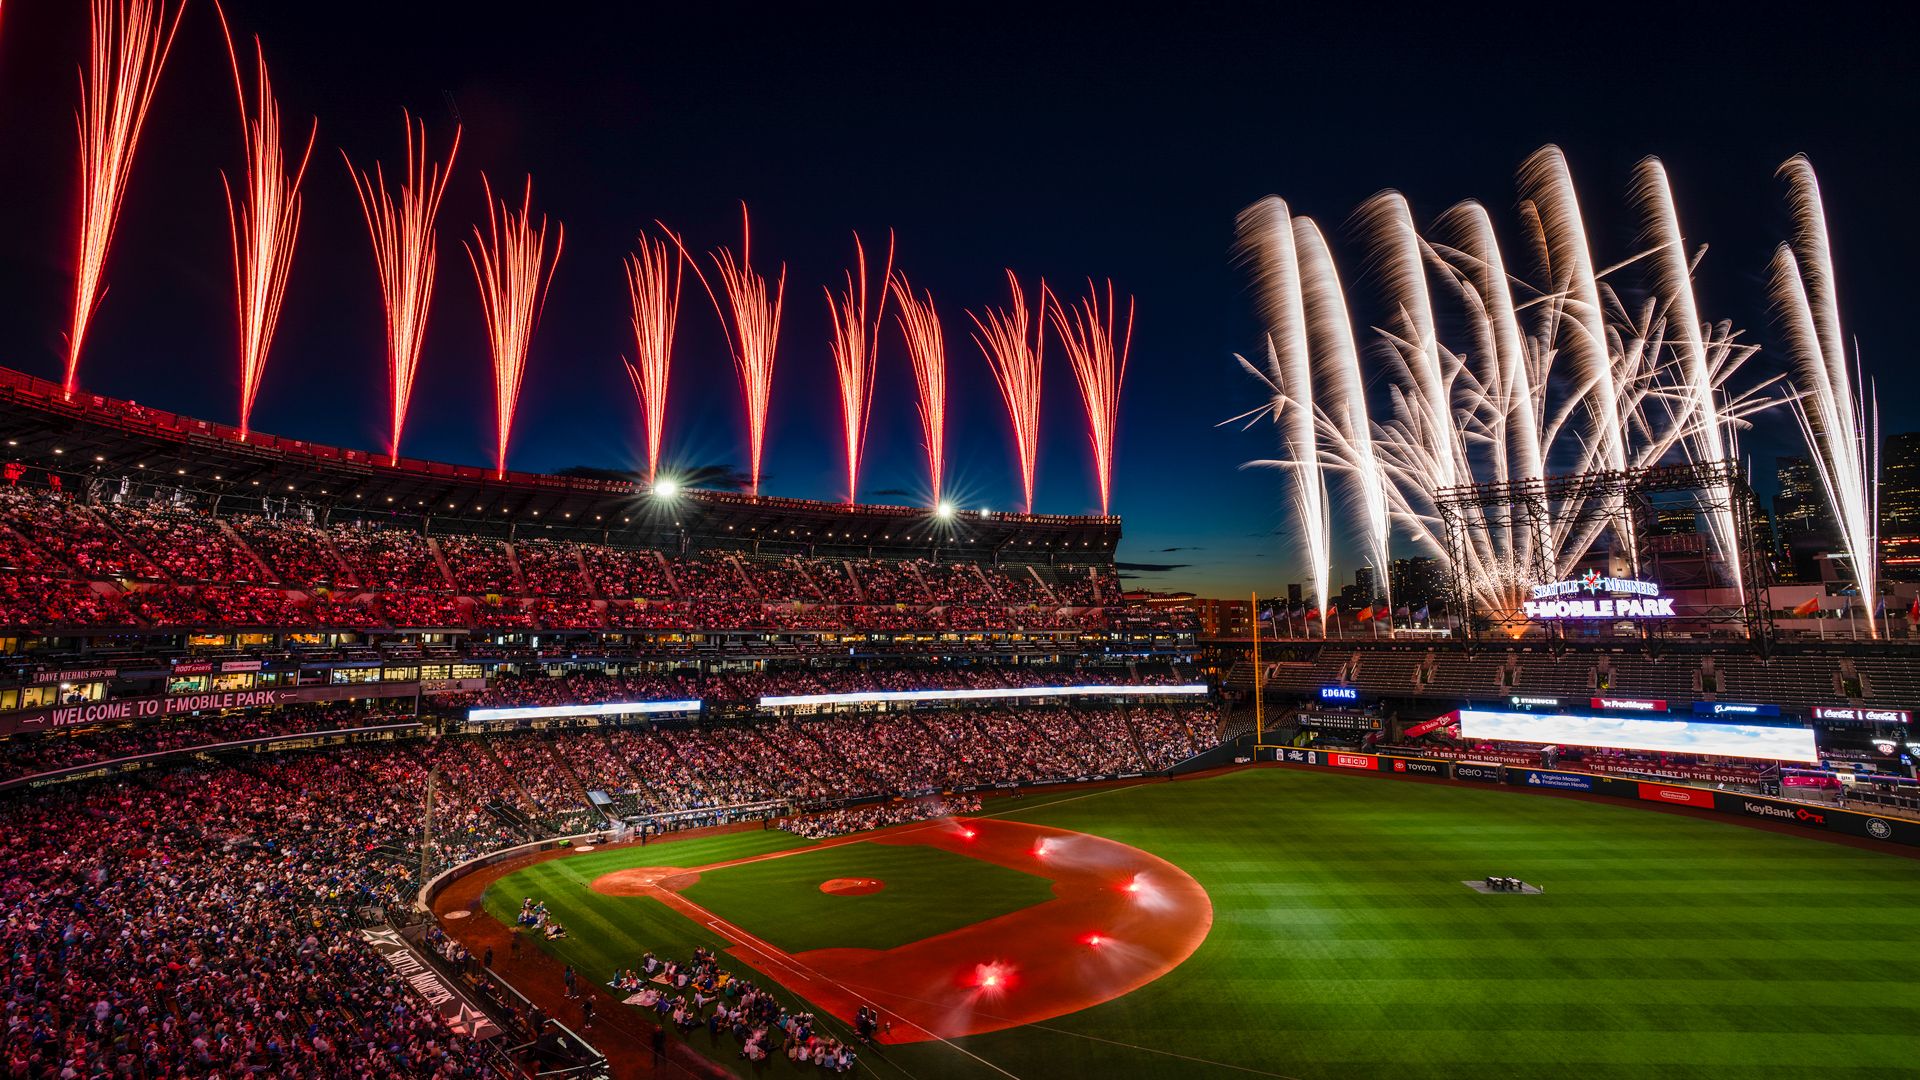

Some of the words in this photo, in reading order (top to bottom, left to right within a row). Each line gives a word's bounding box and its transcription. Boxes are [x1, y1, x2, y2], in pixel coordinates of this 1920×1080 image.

[1533, 580, 1579, 599] SEATTLE
[1604, 577, 1659, 596] MARINERS
[1523, 599, 1614, 618] T-MOBILE
[1616, 598, 1676, 616] PARK
[40, 672, 58, 682] DAVE
[60, 670, 89, 681] NIEHAUS
[1520, 697, 1558, 705] STARBUCKS
[52, 702, 131, 727] WELCOME
[138, 699, 159, 717] TO
[164, 692, 233, 713] T-MOBILE
[235, 690, 276, 707] PARK
[1483, 755, 1530, 765] NORTHWEST
[1407, 763, 1437, 773] TOYOTA
[1458, 767, 1482, 776] eero
[1607, 765, 1644, 773] BIGGEST
[1655, 769, 1679, 777] BEST
[1692, 772, 1712, 780] THE
[1541, 774, 1562, 782] Virginia
[1745, 801, 1796, 819] KeyBank
